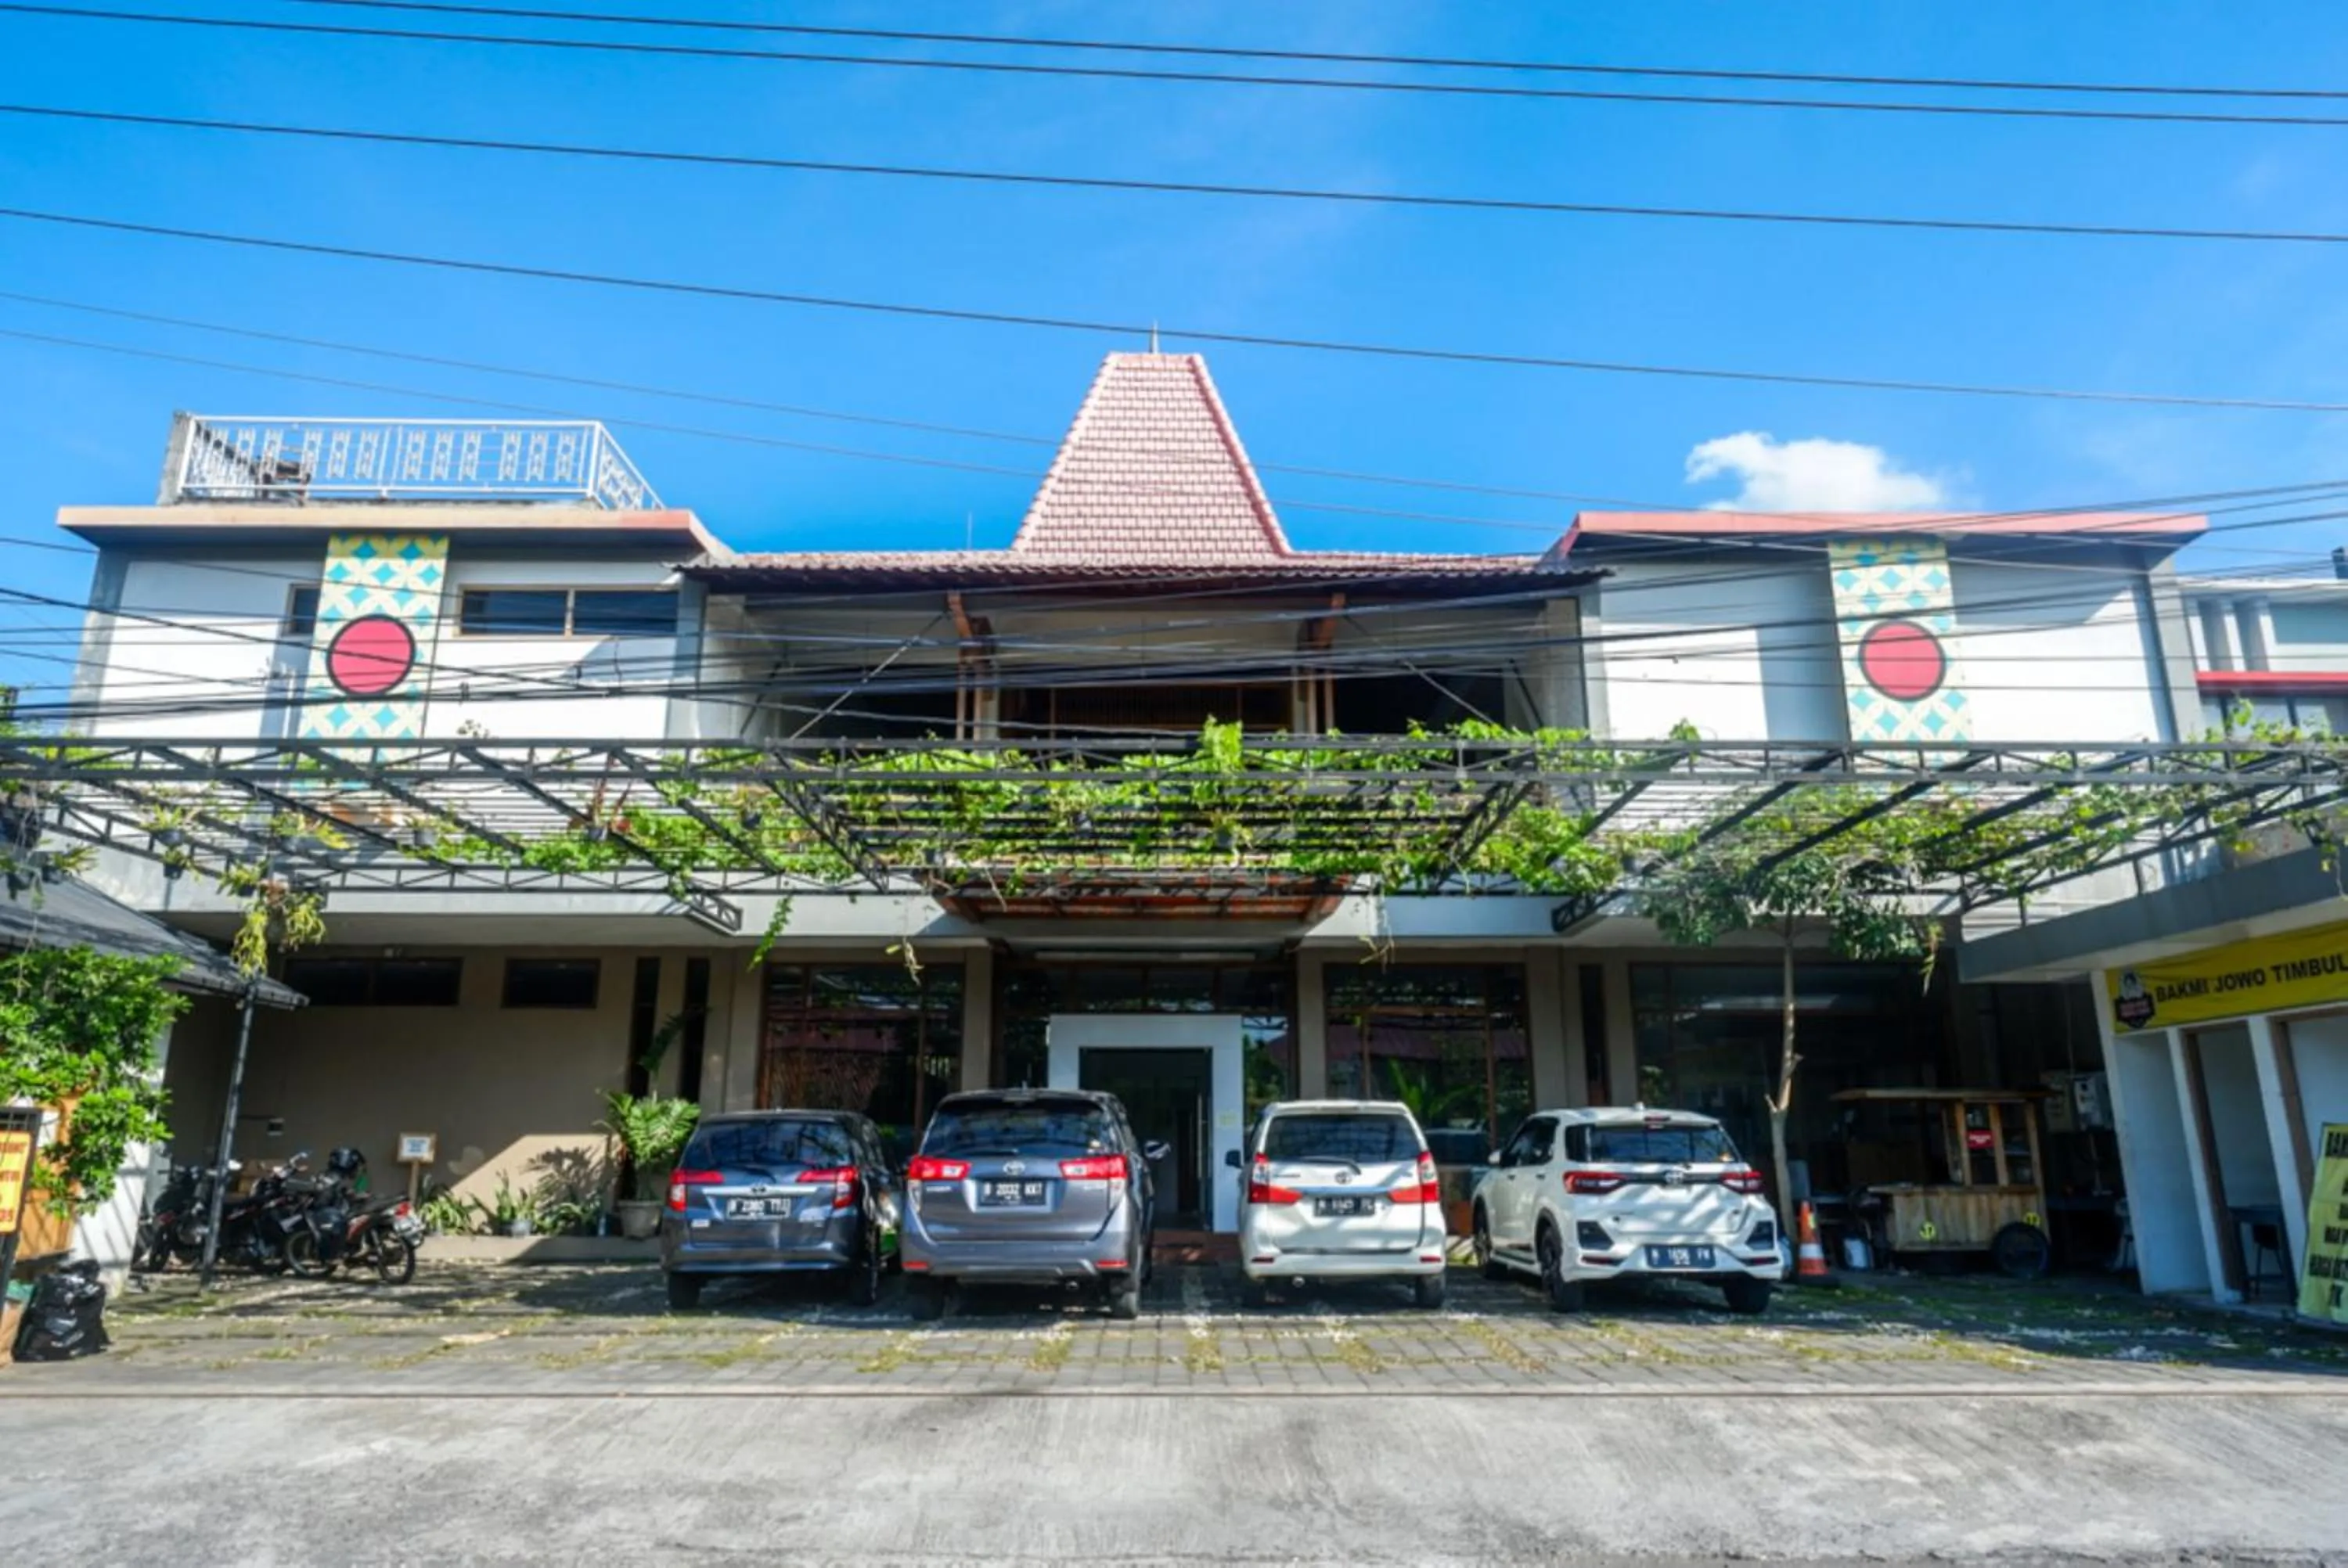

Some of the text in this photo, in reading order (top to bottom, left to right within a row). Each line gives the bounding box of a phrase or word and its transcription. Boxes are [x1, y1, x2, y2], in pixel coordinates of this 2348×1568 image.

[2155, 953, 2348, 1002] BAKMI JOWO TIMBUL
